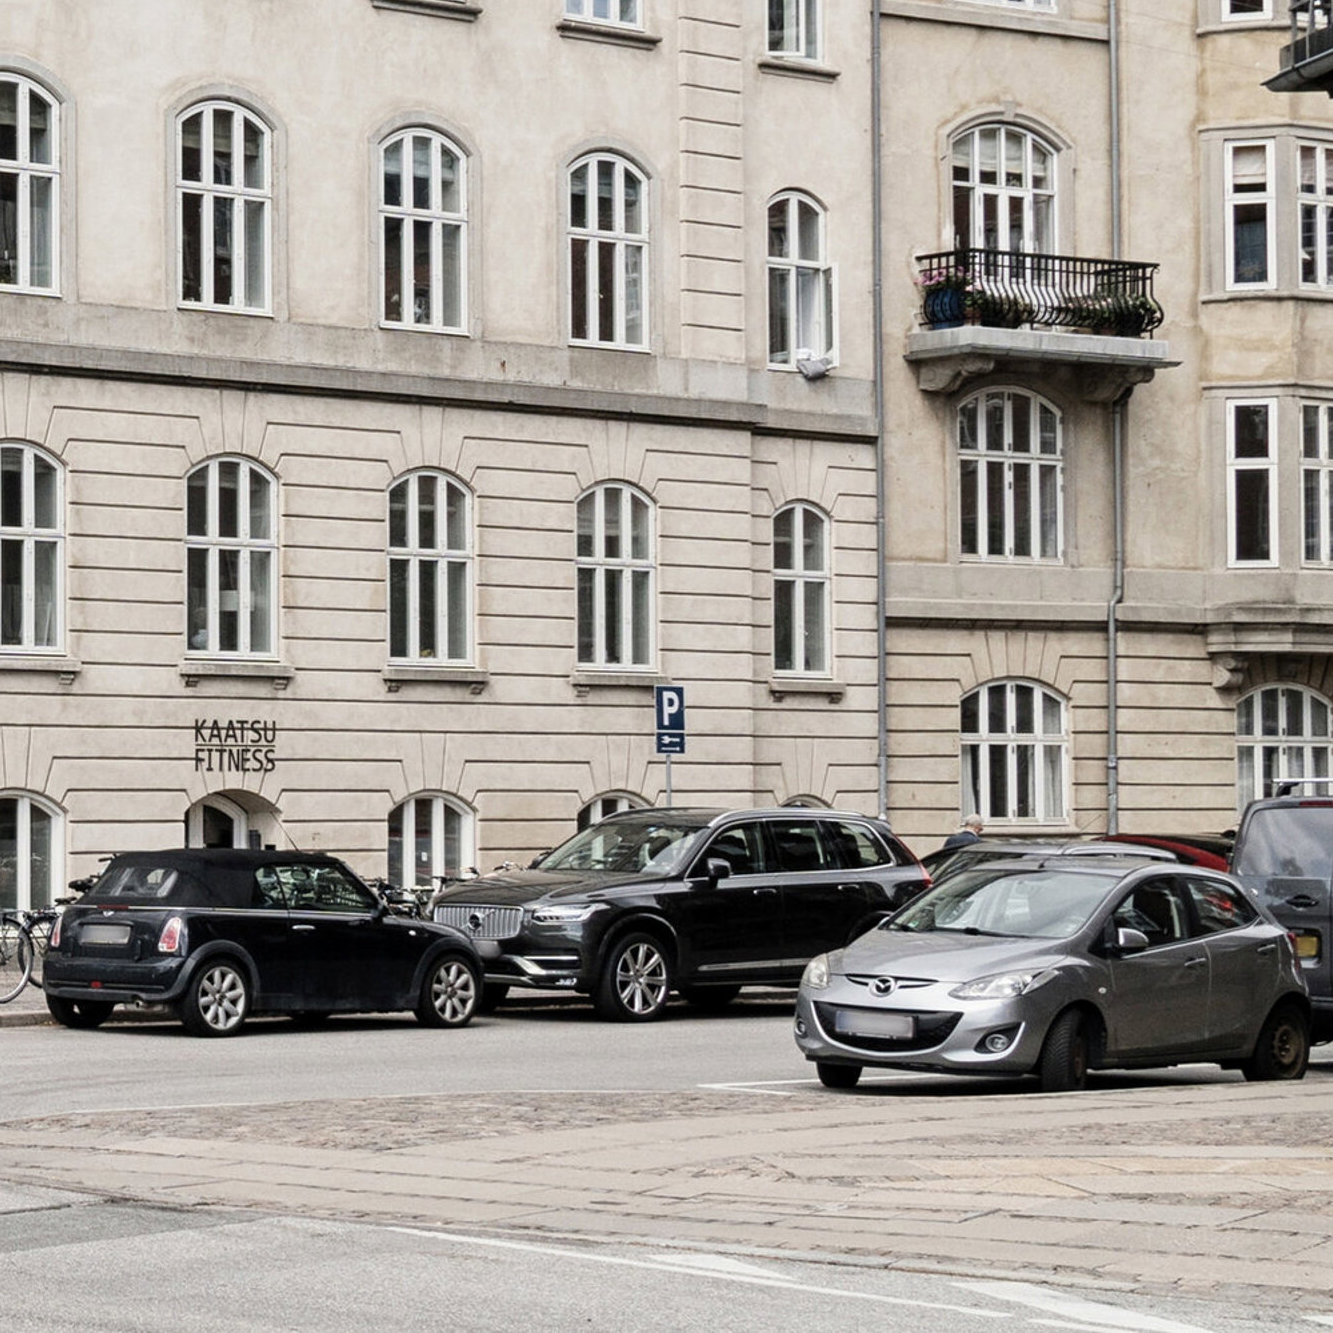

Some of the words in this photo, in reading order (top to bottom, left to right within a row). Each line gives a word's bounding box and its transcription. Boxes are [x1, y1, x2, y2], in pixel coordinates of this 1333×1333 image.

[662, 691, 679, 726] P
[195, 719, 276, 743] KAATSU
[195, 748, 276, 772] FITNESS
